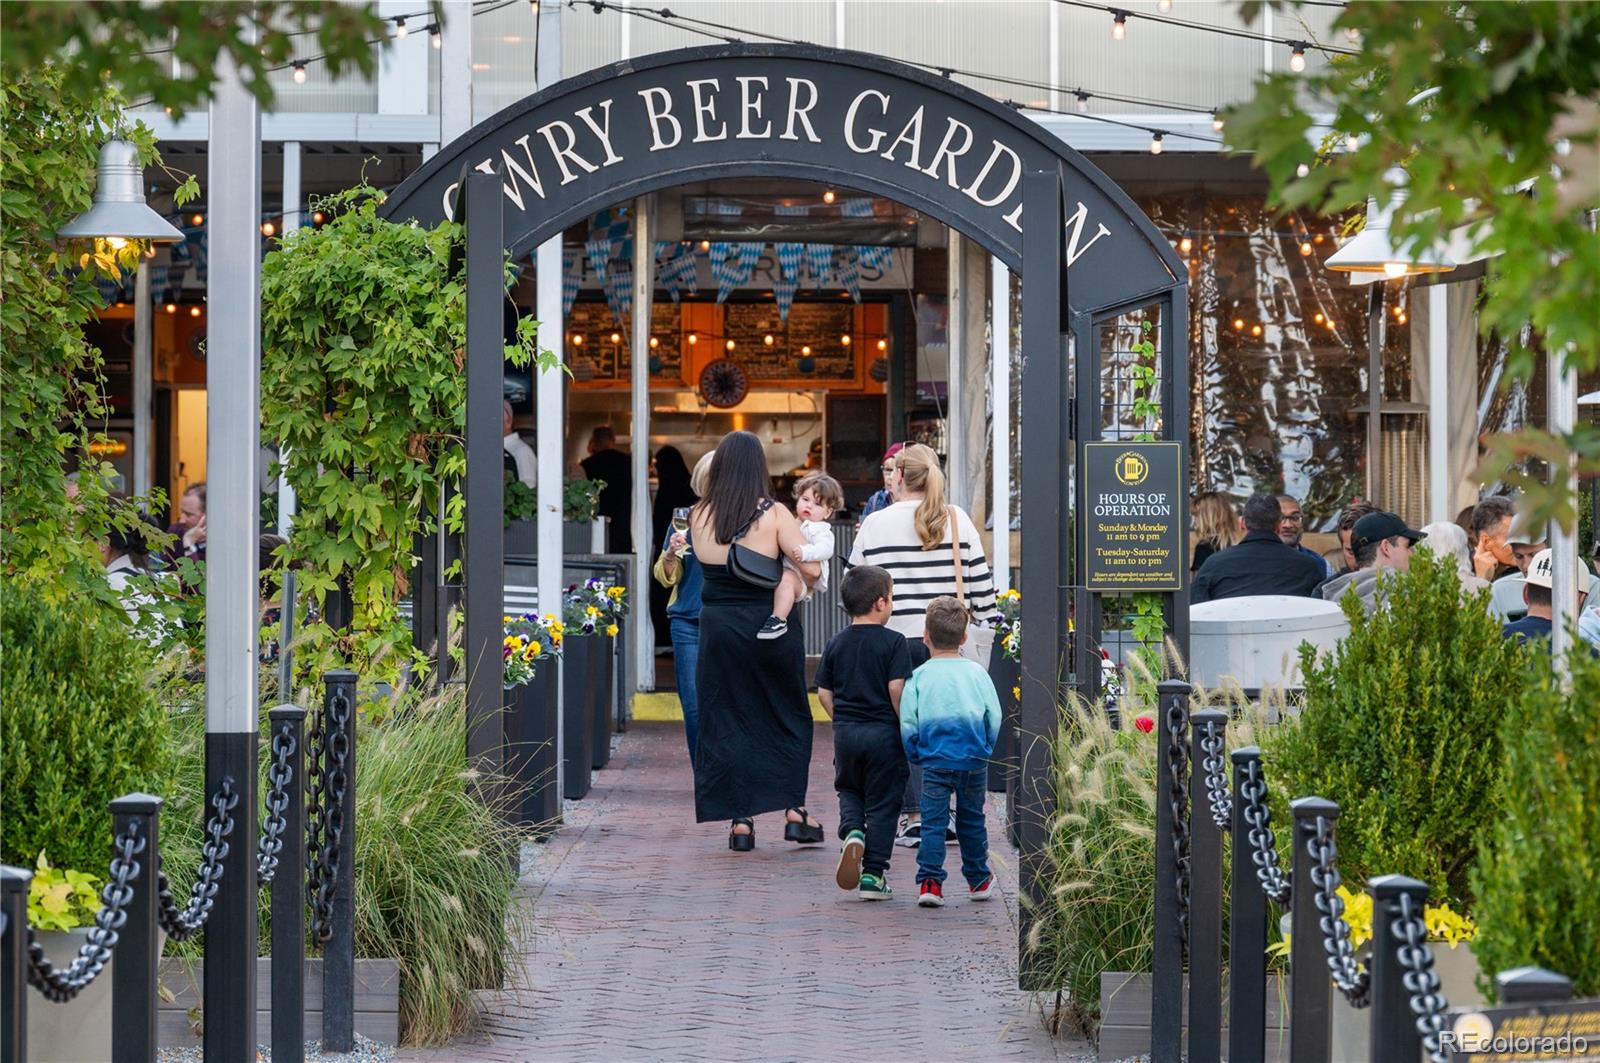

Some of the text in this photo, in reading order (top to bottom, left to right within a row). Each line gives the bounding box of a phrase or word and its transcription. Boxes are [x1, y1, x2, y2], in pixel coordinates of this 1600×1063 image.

[637, 76, 822, 151] BEER
[843, 89, 1111, 267] GARDN
[1099, 493, 1166, 504] HOURS OF
[1094, 505, 1170, 516] OPERATION
[1098, 523, 1129, 533] Sunday
[1138, 523, 1168, 533] Monday
[1139, 534, 1145, 542] 9
[1146, 534, 1160, 542] pm
[1096, 548, 1170, 558] Tuesday-Saturday
[1148, 559, 1162, 567] pm
